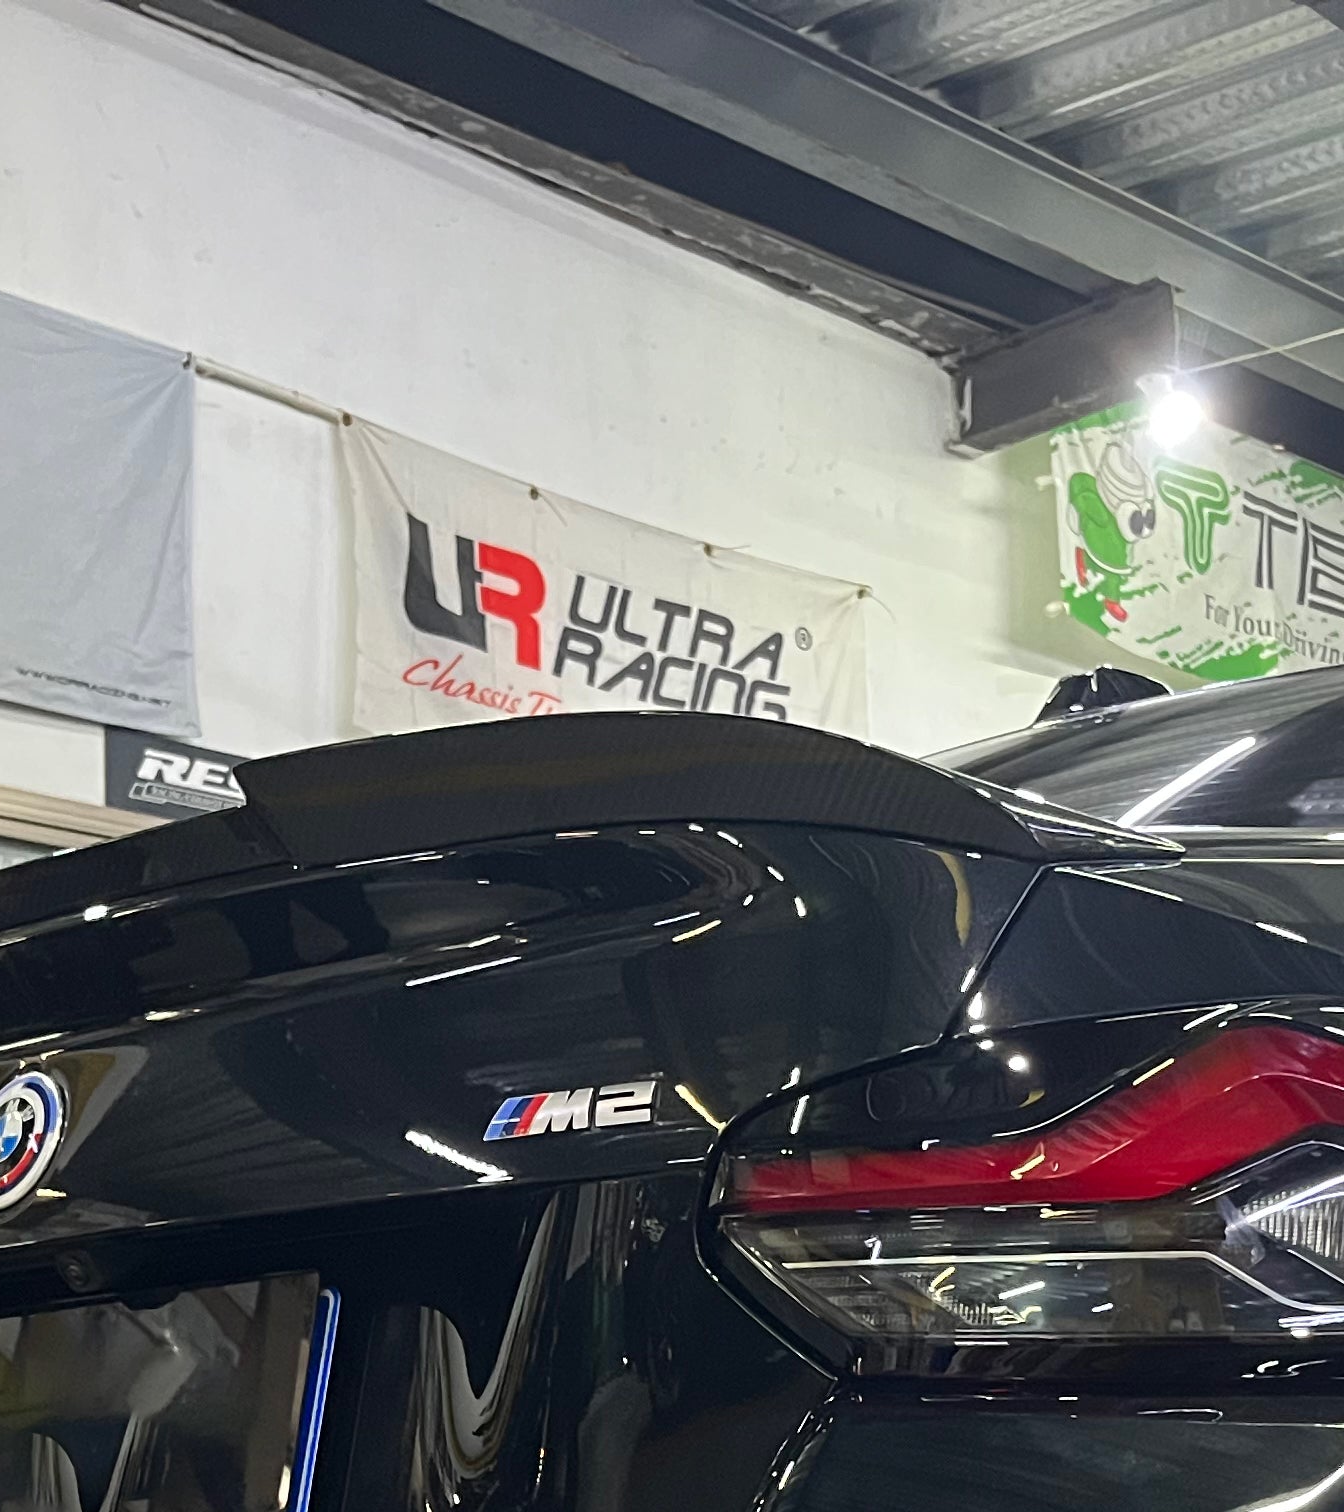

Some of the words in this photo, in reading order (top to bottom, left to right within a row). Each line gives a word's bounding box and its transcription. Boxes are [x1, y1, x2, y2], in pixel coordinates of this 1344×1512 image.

[570, 574, 784, 680] ULTRA
[402, 653, 522, 714] Chassis
[553, 626, 791, 722] RACING
[529, 1081, 657, 1135] M2
